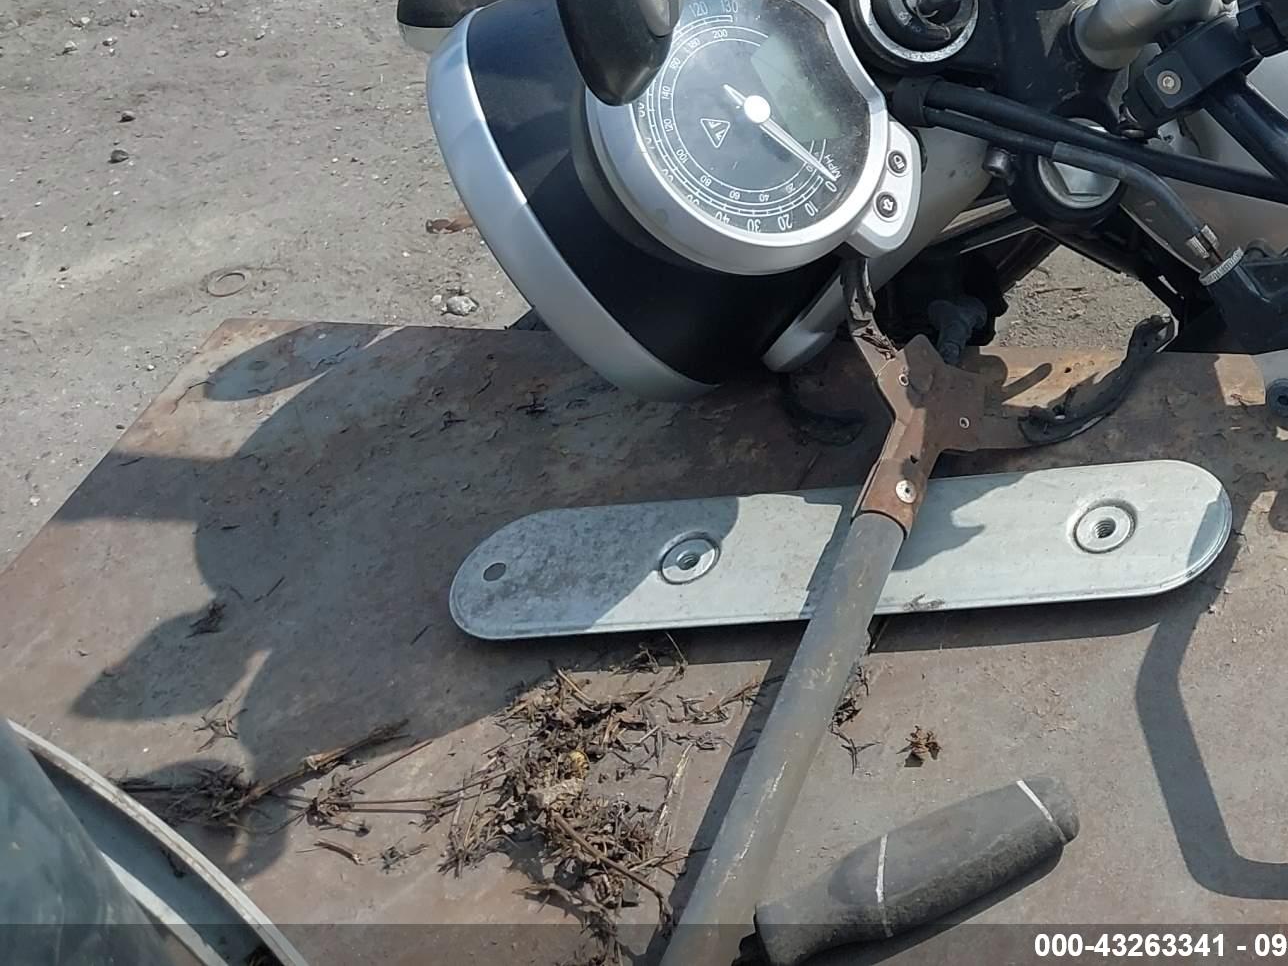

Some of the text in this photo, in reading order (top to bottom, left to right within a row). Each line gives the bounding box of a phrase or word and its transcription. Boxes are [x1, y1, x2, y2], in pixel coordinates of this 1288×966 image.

[689, 0, 709, 18] 120
[712, 29, 728, 40] 200
[661, 85, 671, 100] 140
[663, 118, 674, 132] 120
[676, 149, 689, 165] 100
[824, 153, 844, 180] MPH
[699, 174, 712, 187] 80
[825, 180, 838, 193] 0
[728, 189, 741, 201] 60
[784, 182, 796, 194] 20
[759, 192, 770, 203] 40
[804, 201, 819, 217] 10
[747, 218, 761, 234] 30
[777, 214, 794, 231] 20
